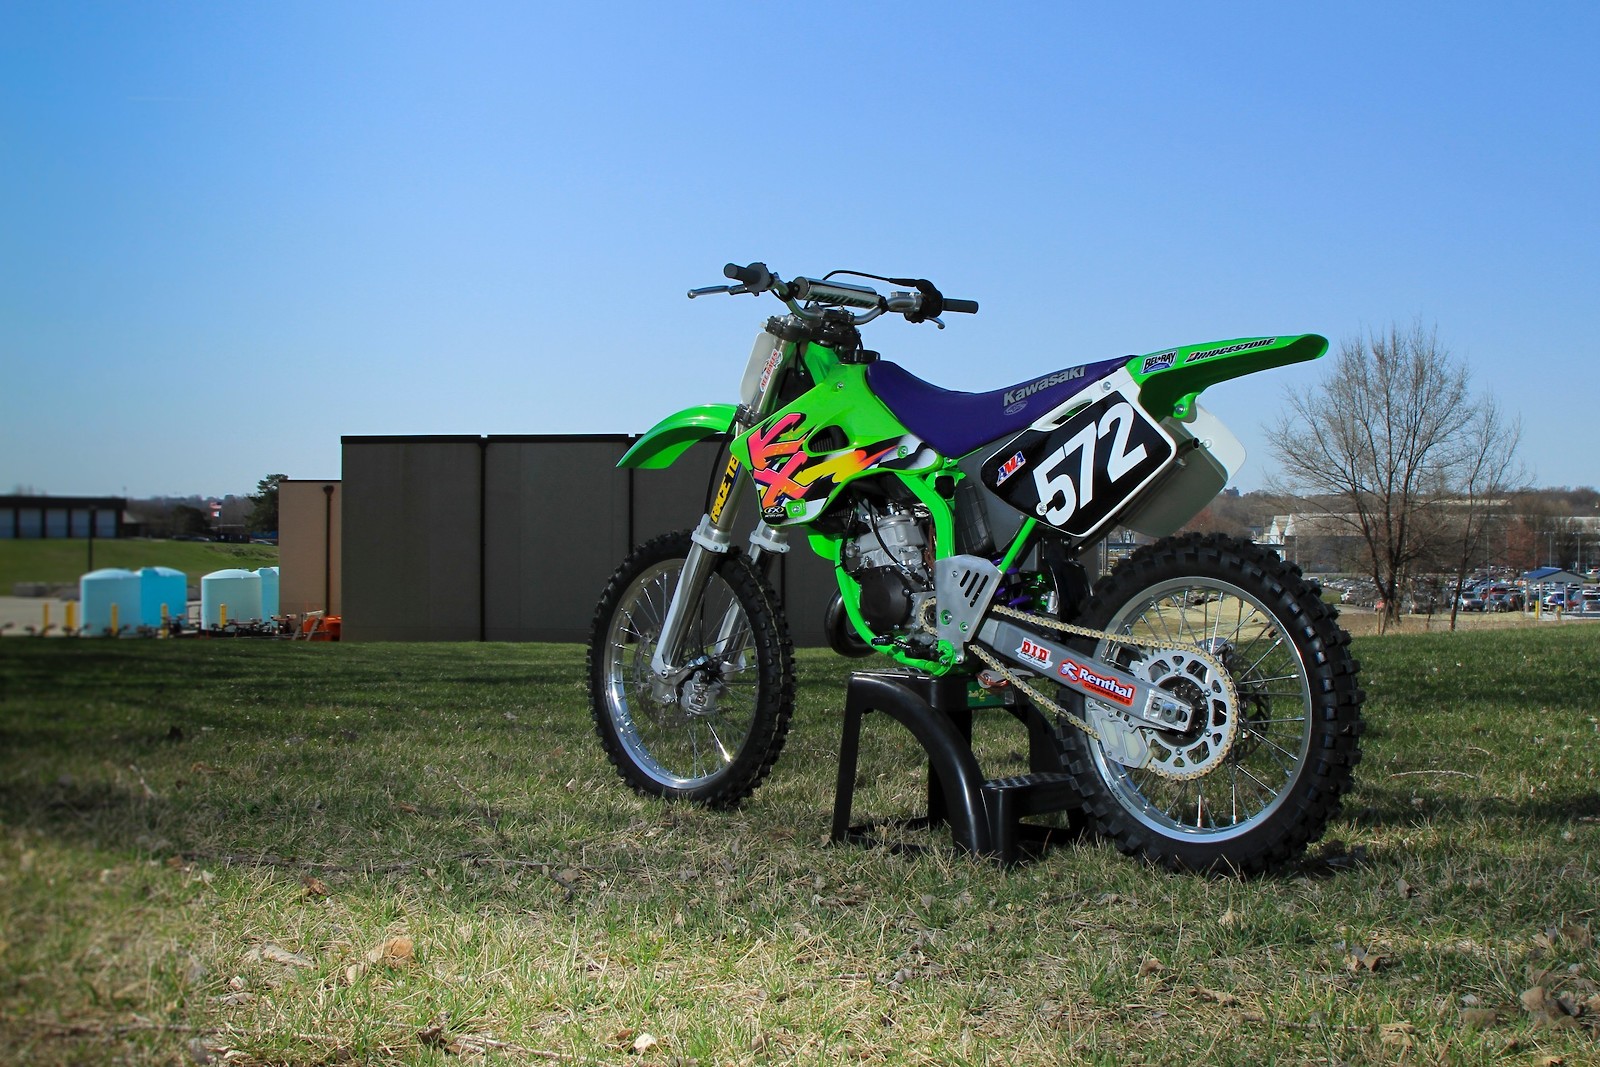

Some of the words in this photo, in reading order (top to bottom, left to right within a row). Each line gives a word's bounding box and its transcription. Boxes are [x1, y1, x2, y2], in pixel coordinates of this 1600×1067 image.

[1186, 337, 1275, 363] BRIDGESTONE
[1003, 366, 1086, 407] Kawasaki
[997, 452, 1024, 484] AMA
[1032, 402, 1147, 526] 572
[710, 481, 732, 524] RACE
[1080, 667, 1134, 698] Renthal
